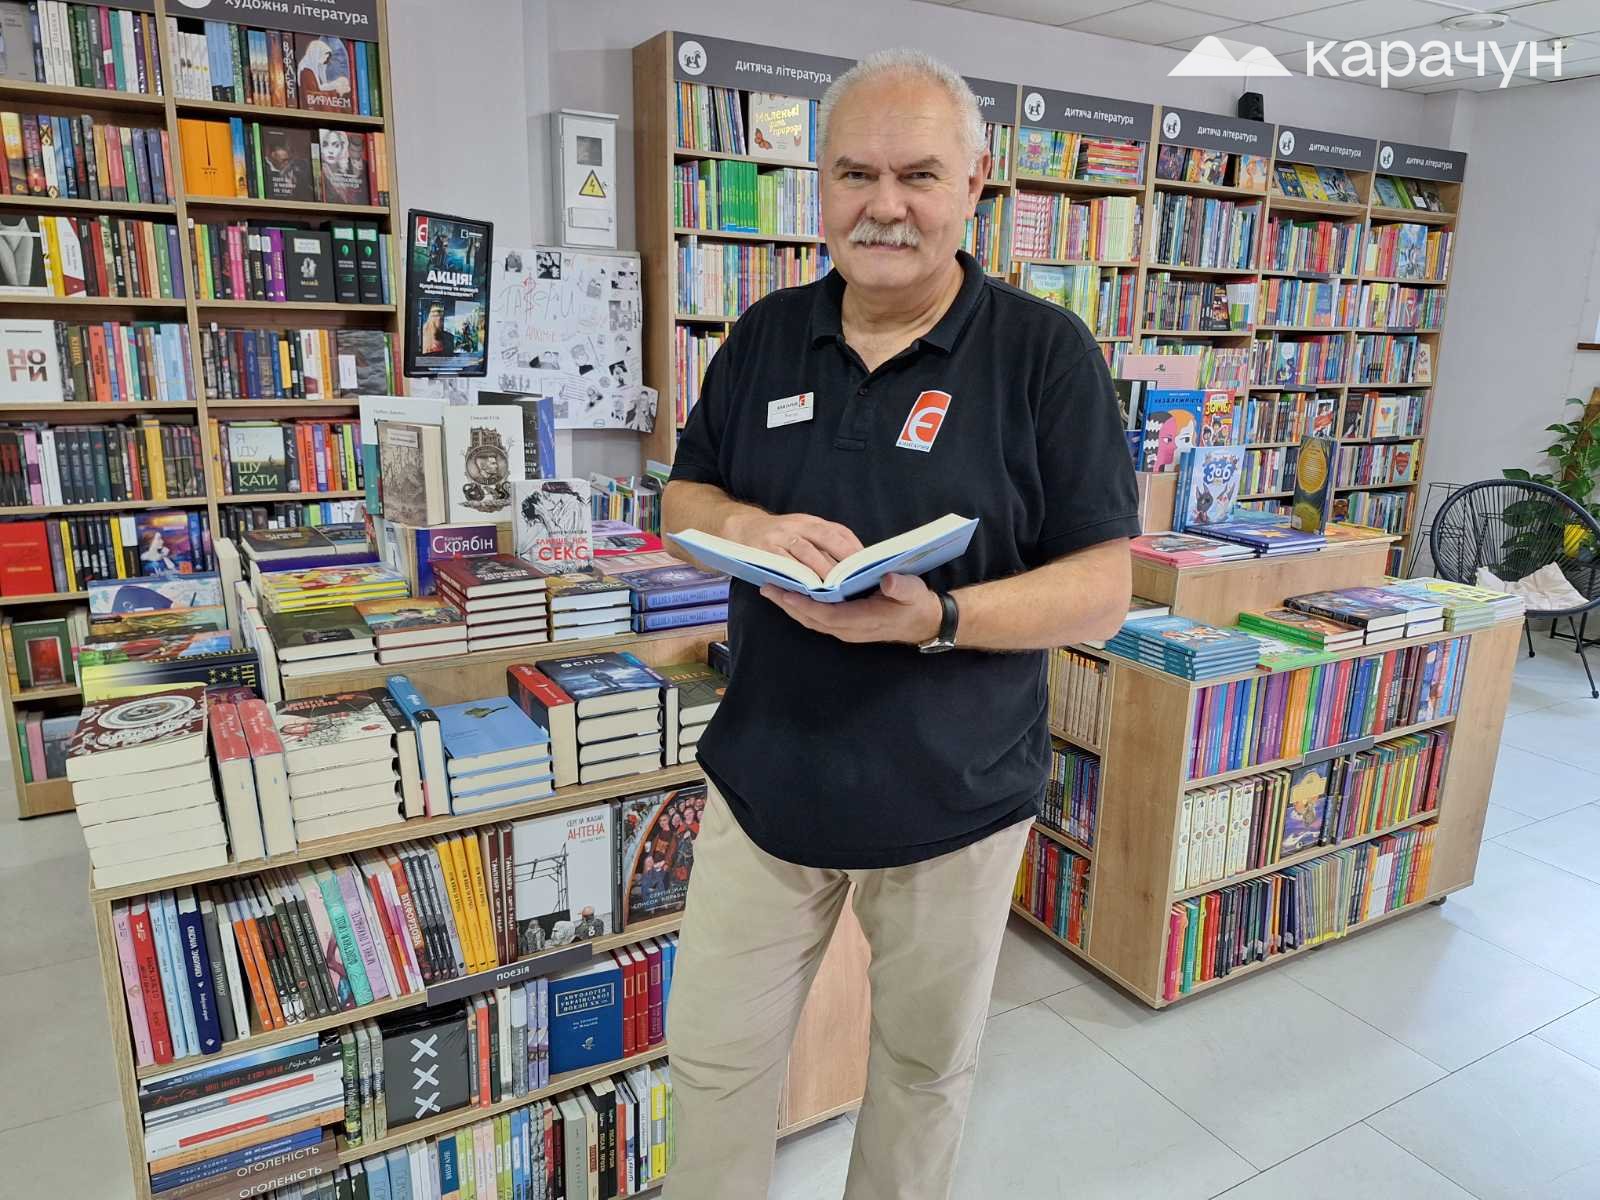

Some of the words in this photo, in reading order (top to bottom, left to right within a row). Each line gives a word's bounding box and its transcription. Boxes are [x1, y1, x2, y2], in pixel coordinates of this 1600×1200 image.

[293, 5, 369, 25] література
[735, 58, 773, 75] дитяча
[775, 64, 832, 84] література
[1064, 105, 1093, 120] дитяча
[1094, 110, 1134, 126] література
[1197, 125, 1220, 138] дитяча
[1221, 129, 1258, 143] література
[1308, 143, 1330, 153] дитяча
[1330, 146, 1362, 158] література
[1406, 156, 1424, 167] дитяча
[1424, 159, 1453, 170] література
[426, 270, 473, 286] АКЦІЯ!
[7, 349, 48, 365] НО
[9, 366, 48, 382] ГИ
[235, 433, 246, 444] Я
[237, 462, 261, 473] ШУ
[239, 474, 279, 486] КАТИ
[432, 535, 494, 556] Скрябін
[538, 545, 589, 561] СЕКС
[567, 821, 605, 841] АНТЕНА
[496, 965, 531, 982] поезія
[560, 992, 610, 1007] УКРАЇНСЬКОЇ
[564, 987, 606, 1001] АНТОЛОГІЯ
[236, 1145, 320, 1178] ОГОЛЕНІСТЬ
[239, 1165, 323, 1199] ОГОЛЕНІСТЬ
